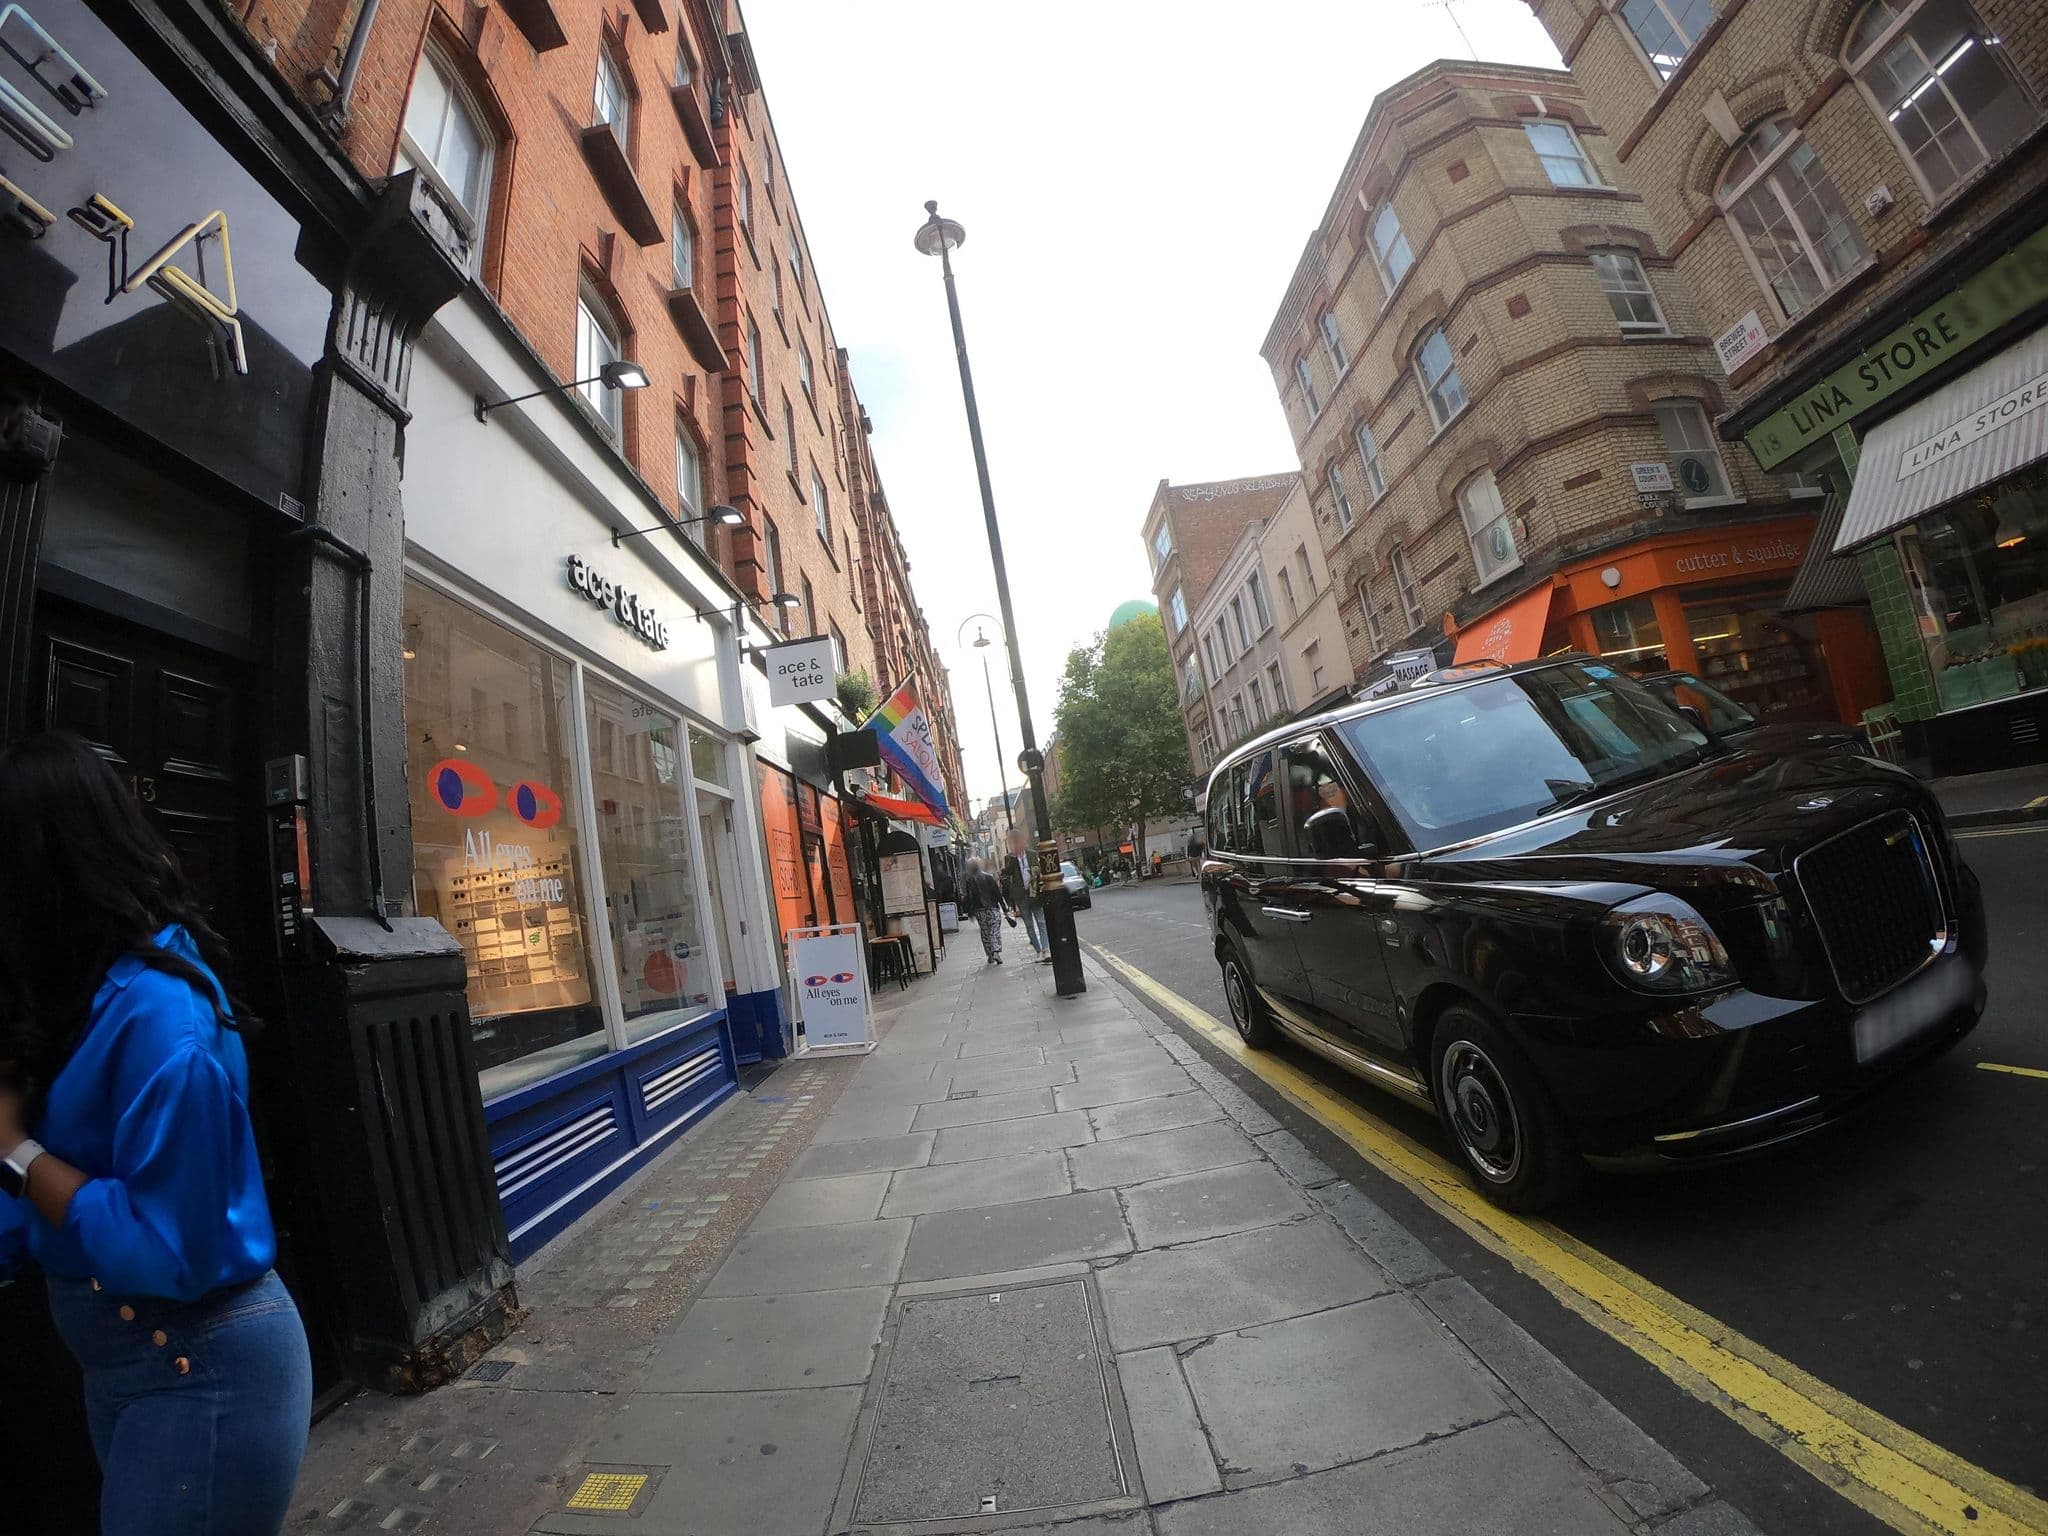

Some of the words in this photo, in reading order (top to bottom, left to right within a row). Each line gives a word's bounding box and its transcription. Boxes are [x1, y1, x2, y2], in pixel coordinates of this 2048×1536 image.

[1719, 324, 1746, 351] BREWER
[1724, 336, 1748, 361] STREET
[1747, 328, 1760, 341] W1
[1790, 385, 1853, 435] LINA
[1858, 302, 1978, 391] STORE
[1912, 431, 1961, 466] LINA
[1638, 475, 1658, 483] COURT
[1676, 552, 1728, 573] cutter
[1732, 545, 1744, 564] &
[1747, 540, 1800, 564] squidge
[568, 553, 614, 610] ace
[631, 593, 671, 650] tate
[778, 661, 806, 675] ace
[810, 657, 821, 670] &
[1395, 664, 1429, 682] MASSAGE
[791, 673, 824, 688] tate
[464, 828, 492, 868] All
[496, 843, 533, 880] eyes
[514, 879, 539, 903] on
[541, 877, 564, 903] me
[806, 988, 820, 1000] All
[821, 988, 840, 1000] eyes
[830, 997, 842, 1006] on
[844, 996, 858, 1006] me
